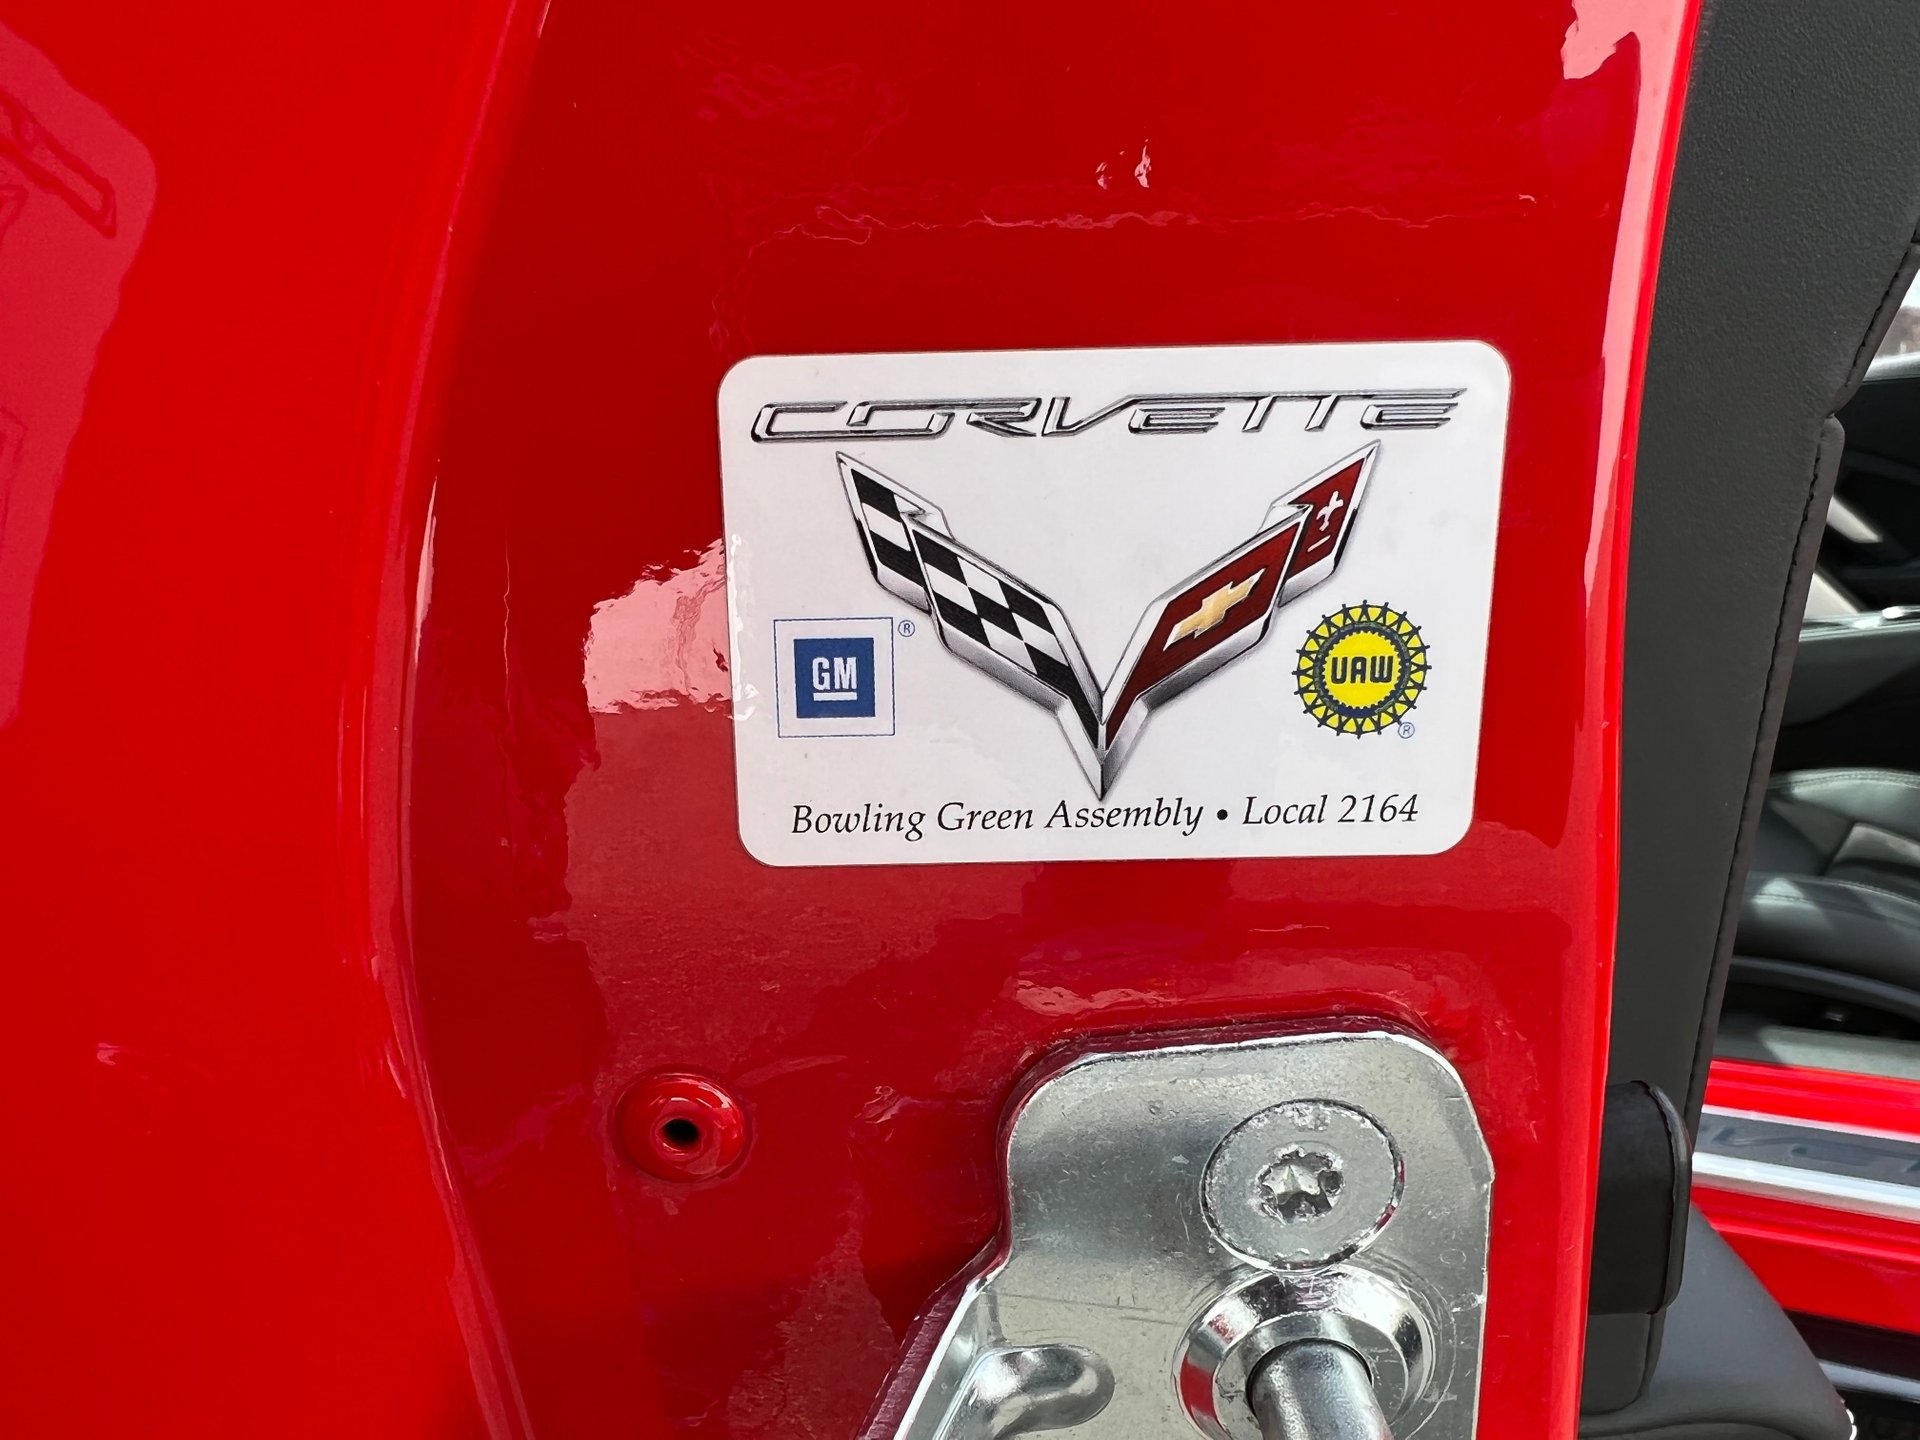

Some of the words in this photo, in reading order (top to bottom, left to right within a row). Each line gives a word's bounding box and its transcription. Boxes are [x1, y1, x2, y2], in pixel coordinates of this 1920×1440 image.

[751, 387, 1467, 443] CORVETTE
[812, 656, 857, 690] GM
[1331, 655, 1394, 684] UAW
[791, 802, 926, 842] Bowling
[937, 801, 1034, 831] Green
[1044, 796, 1204, 837] Assembly
[1242, 794, 1328, 825] Local
[1337, 793, 1419, 823] 2164
